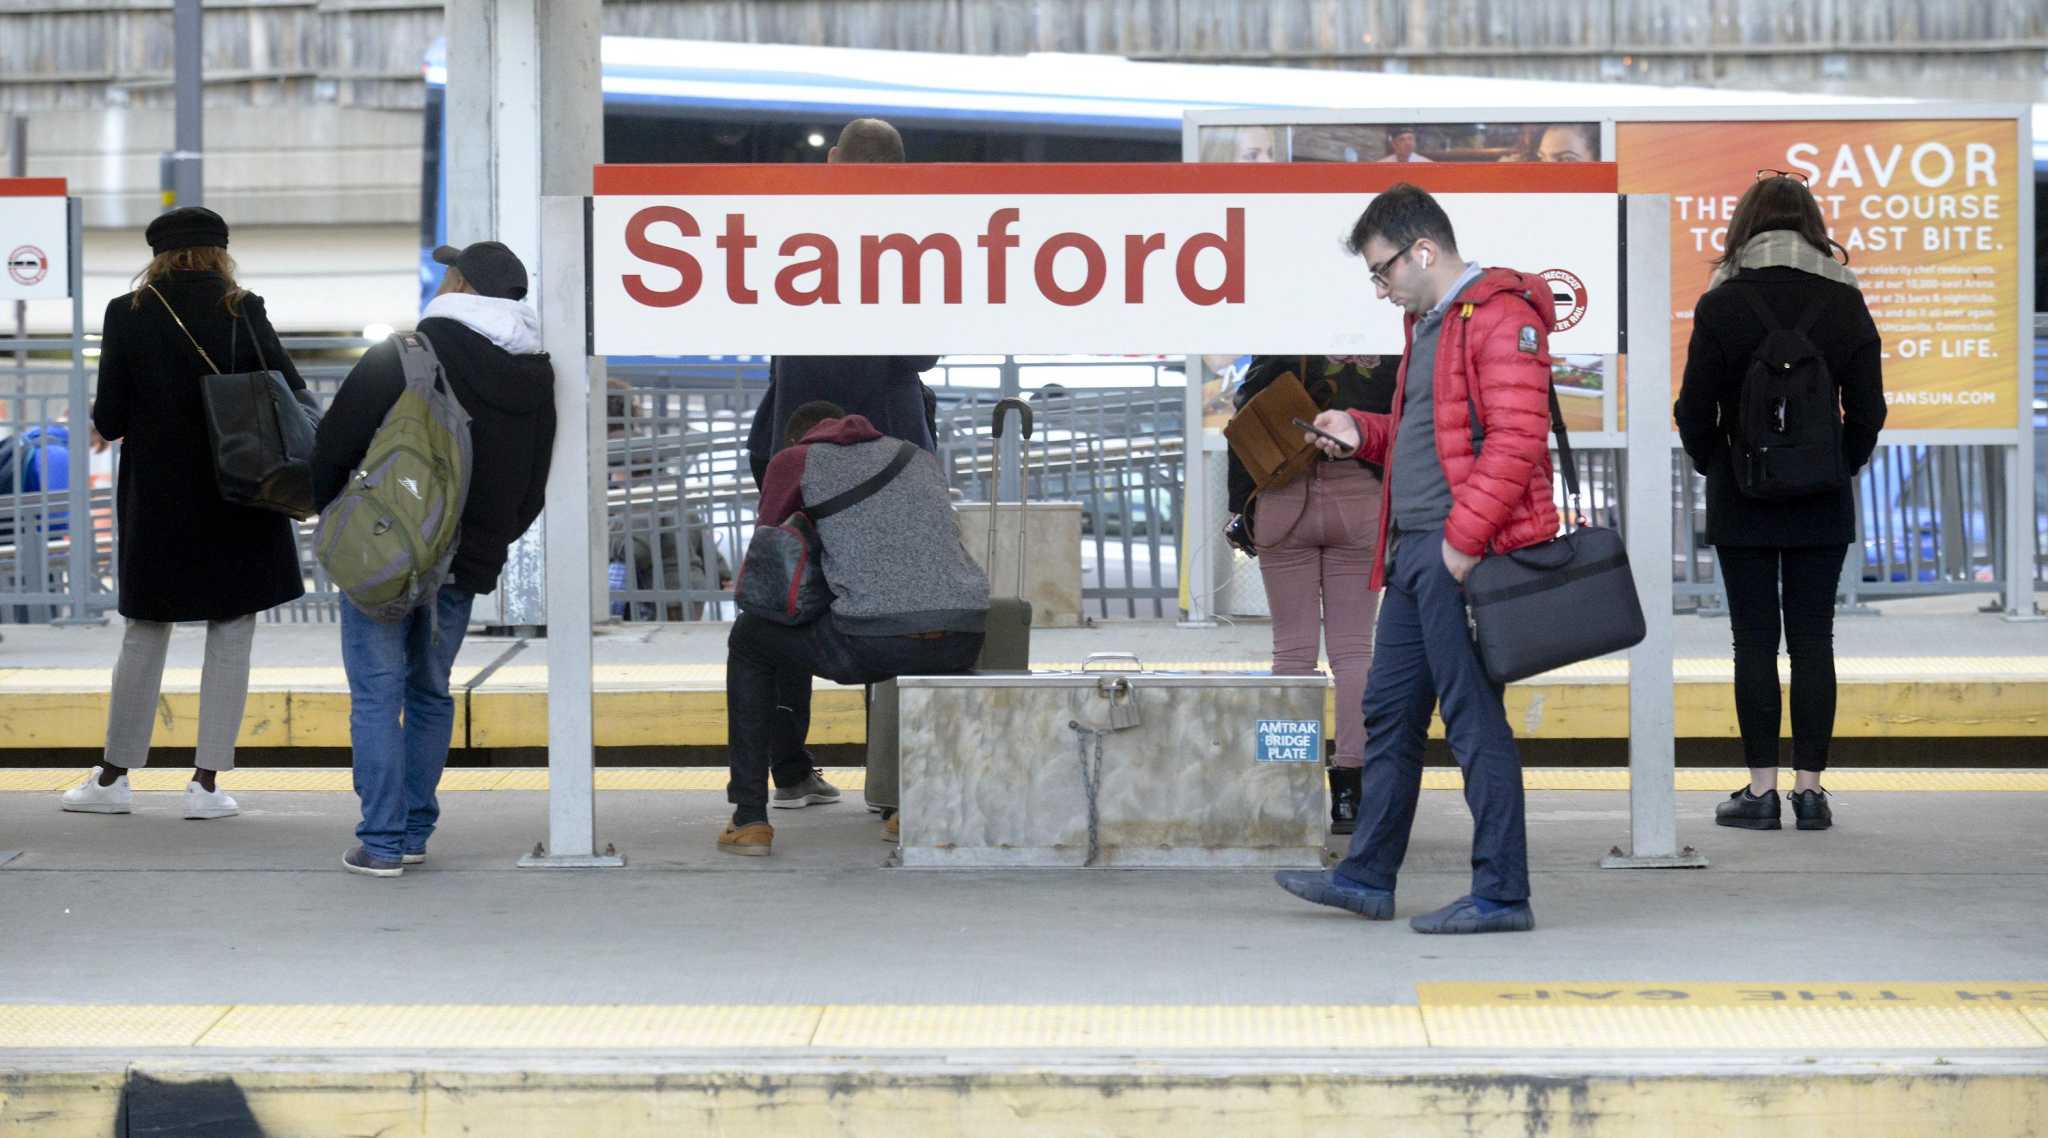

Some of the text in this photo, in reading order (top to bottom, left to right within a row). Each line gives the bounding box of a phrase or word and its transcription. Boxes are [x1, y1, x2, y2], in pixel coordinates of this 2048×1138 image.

[1786, 142, 1998, 188] SAVOR
[1675, 195, 1739, 220] THE
[1859, 194, 2000, 220] COURSE
[1826, 226, 1908, 251] LAST
[1923, 226, 2004, 251] BITE.
[621, 205, 1246, 308] Stamford
[1898, 338, 1933, 358] OF
[1941, 338, 1999, 358] LIFE.
[1883, 391, 1996, 405] GANSUN.COM
[1259, 721, 1317, 734] AMTRAK
[1264, 735, 1311, 747] BRIDGE
[1268, 748, 1308, 760] PLATE
